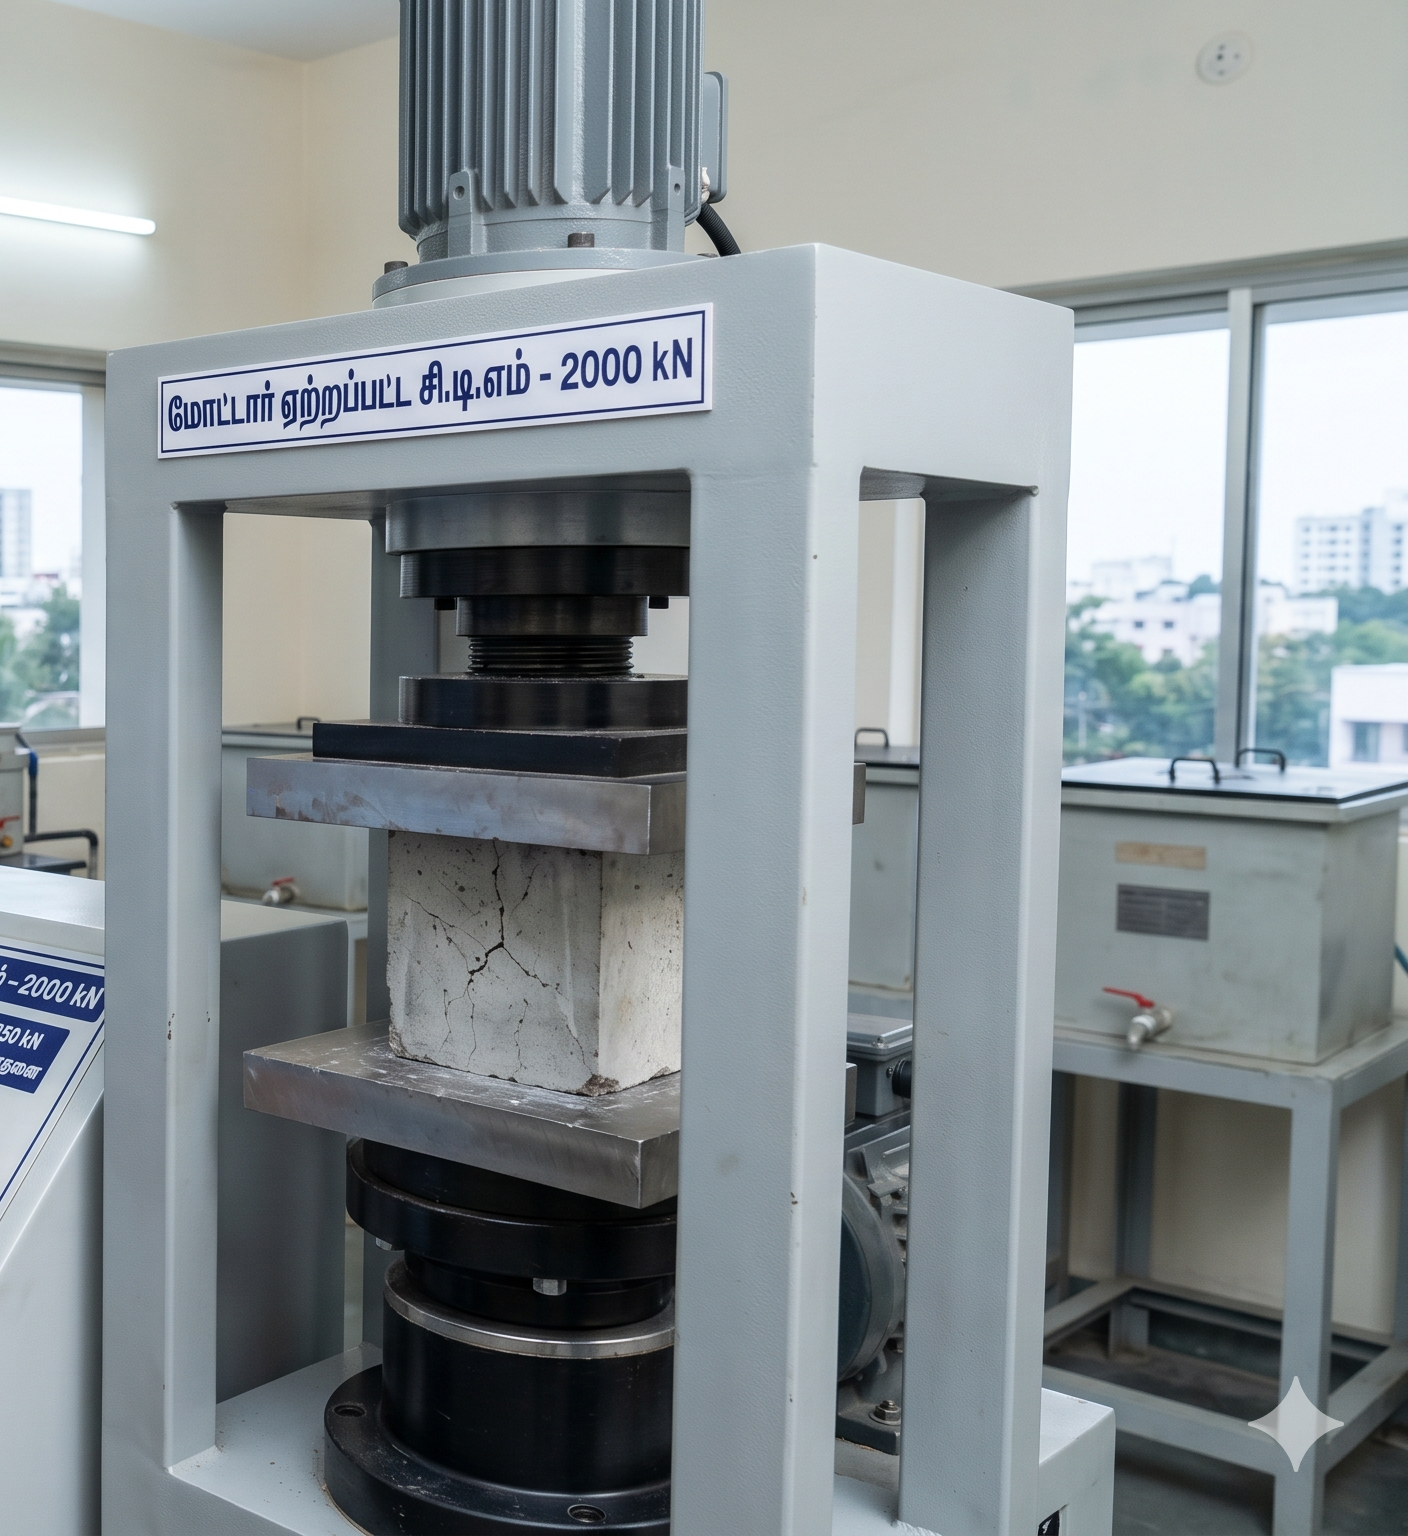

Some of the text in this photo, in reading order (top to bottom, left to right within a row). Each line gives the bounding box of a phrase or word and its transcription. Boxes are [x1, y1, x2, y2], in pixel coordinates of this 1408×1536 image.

[167, 379, 273, 432] மோட்டார்
[281, 370, 412, 431] ஏற்றப்பட்ட
[418, 347, 531, 412] சி.டி.எம்
[560, 344, 643, 391] 2000
[653, 337, 693, 382] kN
[17, 974, 73, 1003] 2000
[69, 983, 105, 1010] kN
[18, 1030, 44, 1050] kN
